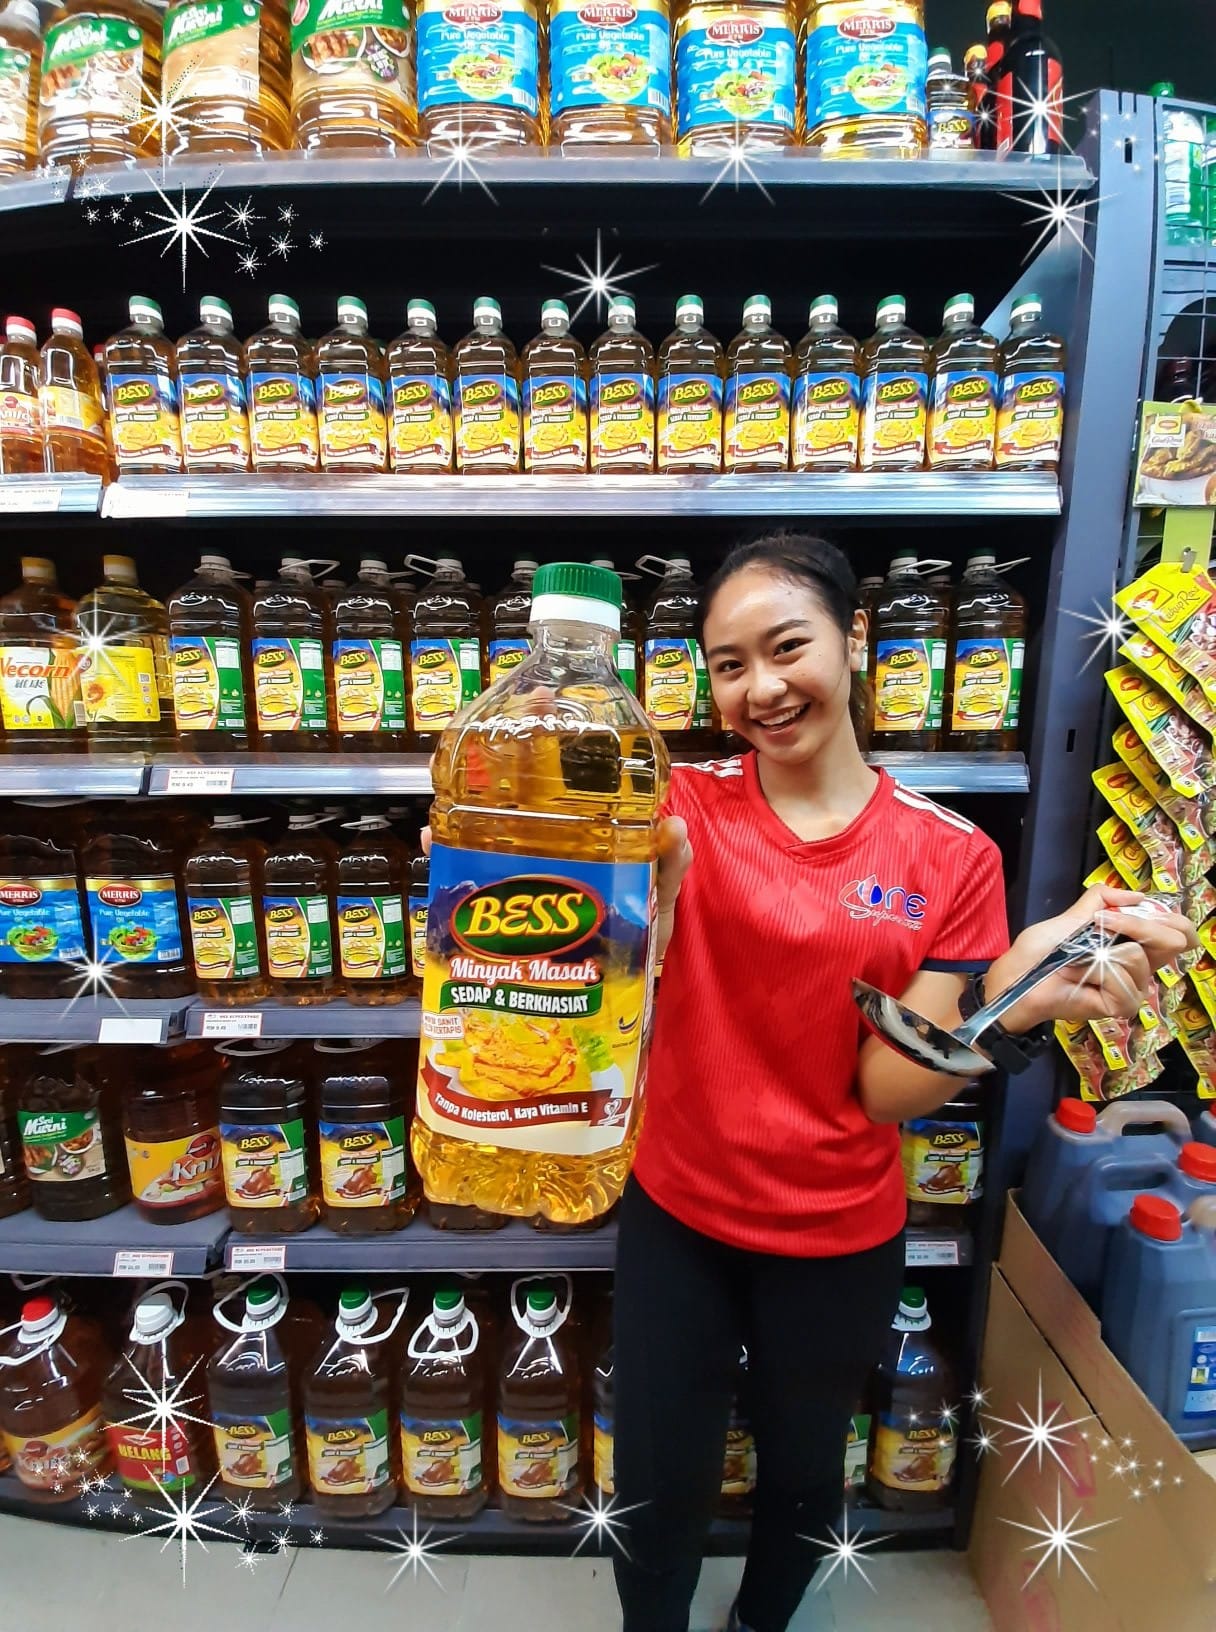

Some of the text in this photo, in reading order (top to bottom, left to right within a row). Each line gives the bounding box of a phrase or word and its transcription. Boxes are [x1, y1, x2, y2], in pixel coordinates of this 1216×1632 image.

[449, 6, 499, 18] MERRIS
[584, 7, 633, 18] MERRIS
[711, 24, 760, 36] MERRIS
[843, 18, 892, 31] MERRIS
[118, 384, 151, 400] BESS
[258, 382, 291, 399] BESS
[397, 383, 428, 401] BESS
[465, 383, 497, 401] BESS
[535, 383, 567, 403] BESS
[603, 382, 635, 401] BESS
[674, 382, 707, 400] BESS
[742, 382, 775, 400] BESS
[812, 381, 845, 398] BESS
[882, 381, 914, 398] BESS
[952, 381, 984, 398] BESS
[1021, 381, 1053, 398] BESS
[175, 649, 201, 663] BESS
[258, 650, 285, 665] BESS
[339, 651, 366, 666] BESS
[418, 651, 445, 666] BESS
[497, 652, 523, 666] BESS
[655, 651, 682, 665] BESS
[889, 650, 918, 666] BESS
[970, 650, 999, 666] BESS
[0, 657, 70, 678] Vecorn
[0, 890, 38, 899] MERRIS
[102, 890, 139, 899] MERRIS
[193, 908, 218, 921] BESS
[269, 907, 294, 920] BESS
[344, 907, 369, 920] BESS
[463, 893, 584, 937] BESS
[450, 958, 598, 986] Minyak Masak
[451, 986, 589, 1013] SEDAP & BERKHASIAT
[434, 1092, 588, 1122] Tanpa Kolesterol, Kaya Vitamin E
[24, 1118, 67, 1136] Murni
[240, 1135, 271, 1149] BESS
[343, 1134, 373, 1148] BESS
[934, 1133, 964, 1145] BESS
[229, 1425, 256, 1435] BESS
[327, 1431, 356, 1442] BESS
[423, 1431, 451, 1441] BESS
[522, 1432, 551, 1443] BESS
